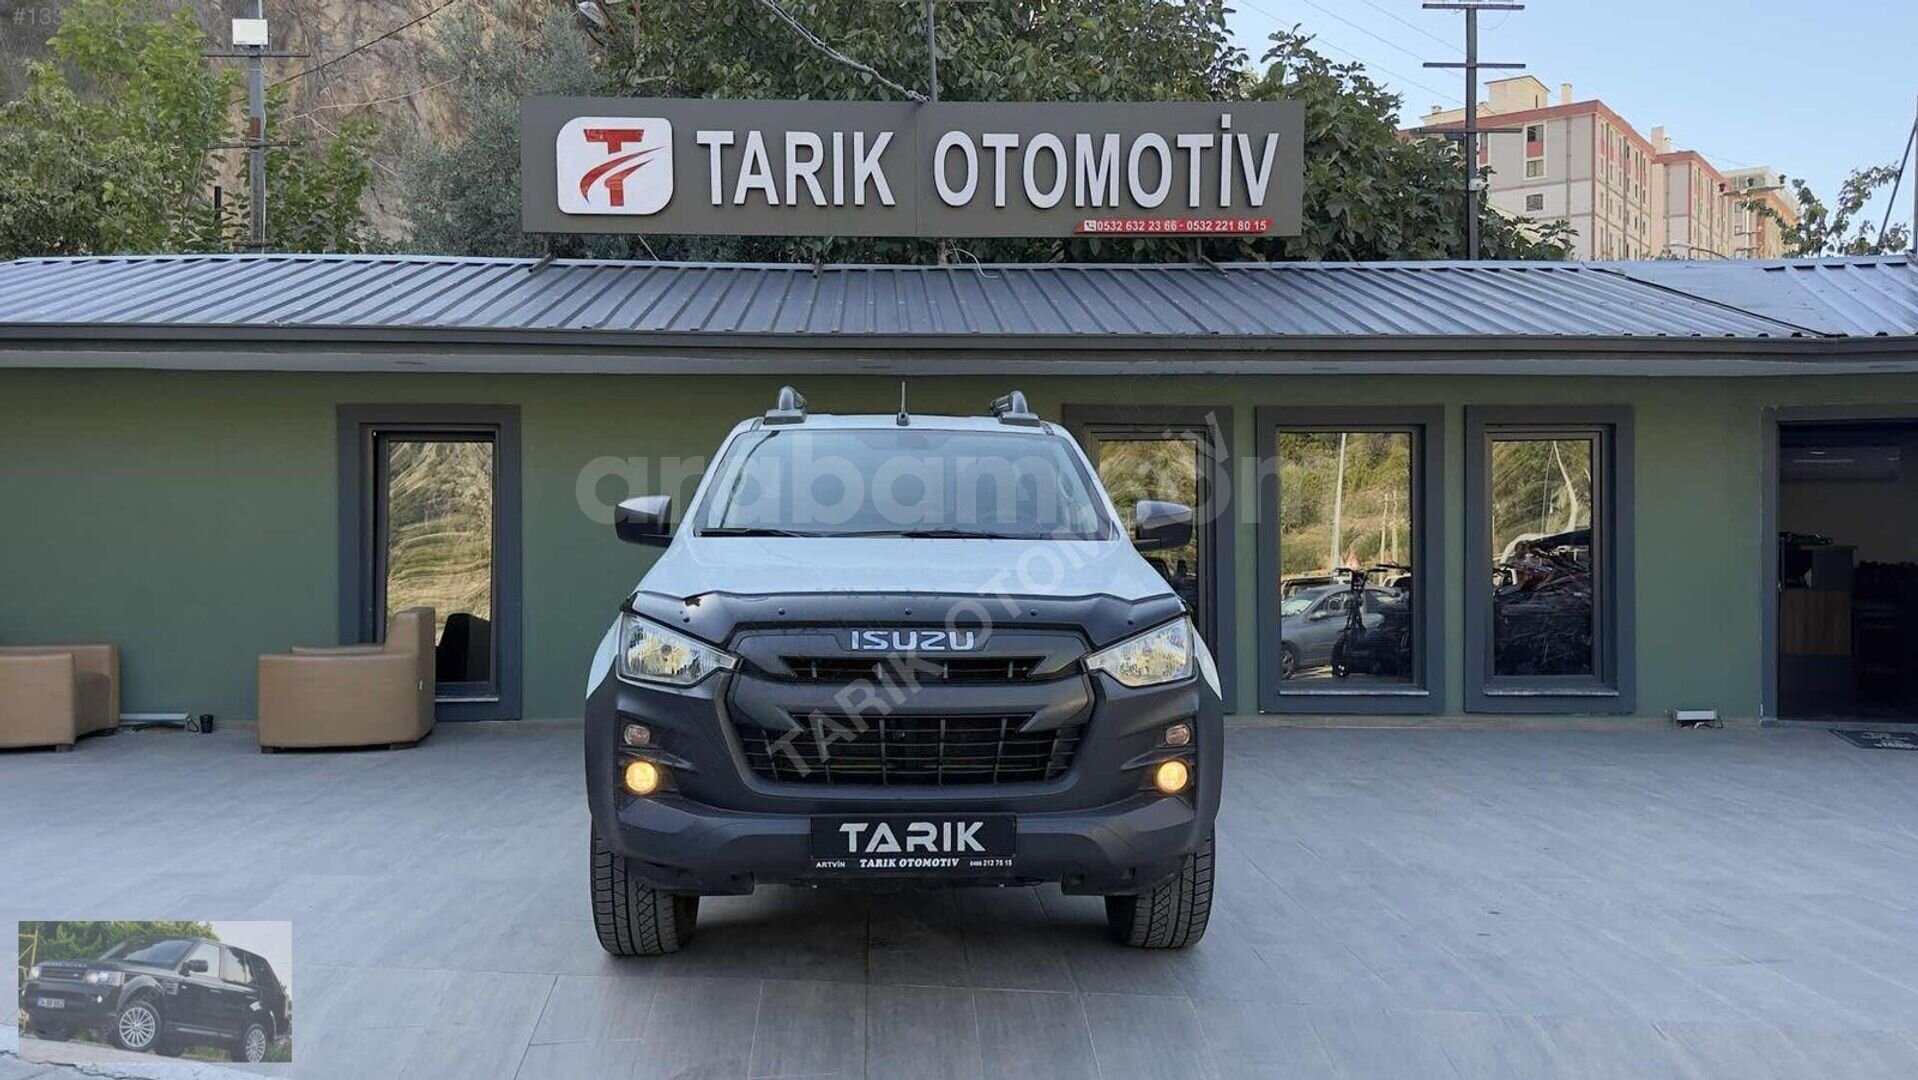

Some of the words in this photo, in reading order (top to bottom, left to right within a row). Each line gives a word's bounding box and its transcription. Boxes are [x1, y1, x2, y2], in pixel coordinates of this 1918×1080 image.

[697, 130, 896, 206] TARIK
[934, 113, 1279, 209] OTOMOTİV
[1097, 219, 1123, 231] 0532
[1126, 219, 1145, 231] 632
[1148, 220, 1161, 231] 23
[1187, 219, 1211, 231] 0532
[1215, 219, 1234, 231] 221
[1237, 219, 1250, 231] 80
[1254, 219, 1266, 230] 15
[851, 630, 975, 650] ISUZU
[839, 821, 986, 853] TARIK
[859, 858, 897, 868] TARIK
[983, 859, 994, 867] 212
